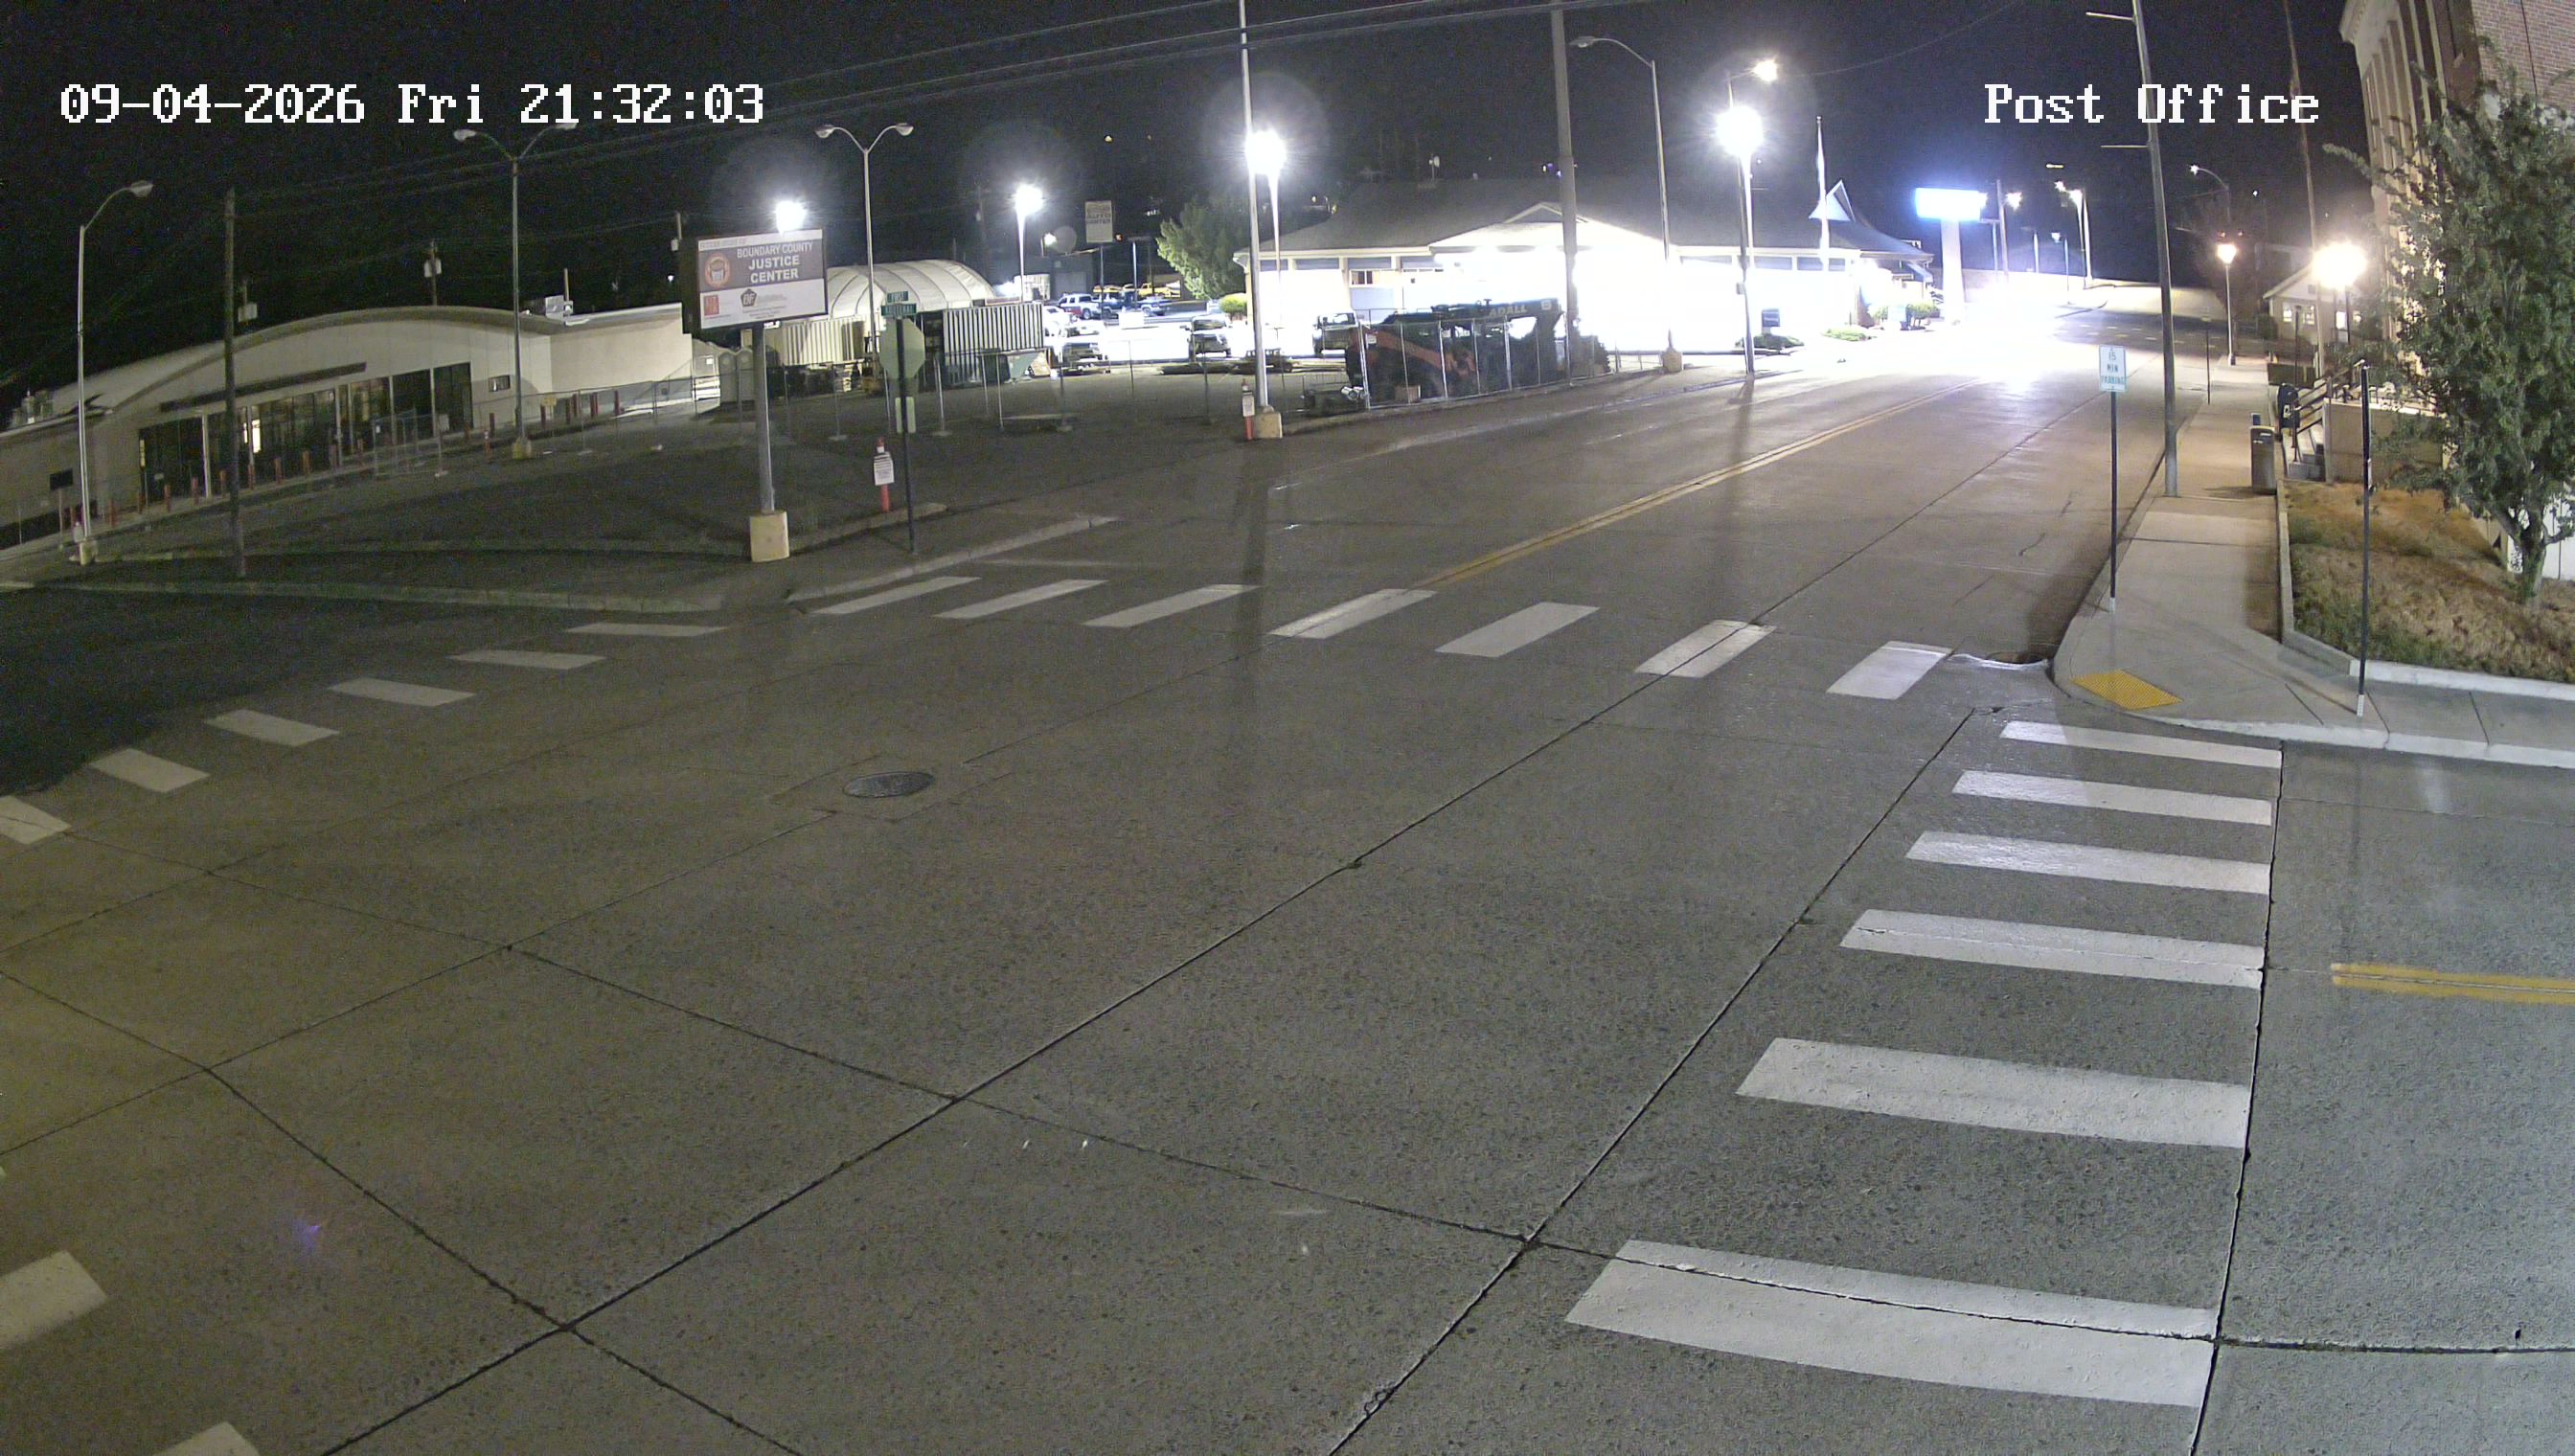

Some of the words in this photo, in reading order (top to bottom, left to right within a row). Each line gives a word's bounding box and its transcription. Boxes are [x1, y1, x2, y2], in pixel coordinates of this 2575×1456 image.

[737, 244, 781, 259] BOUNDARY
[782, 240, 812, 254] COUNTY
[748, 254, 800, 270] JUSTICE
[750, 267, 799, 284] CENTER
